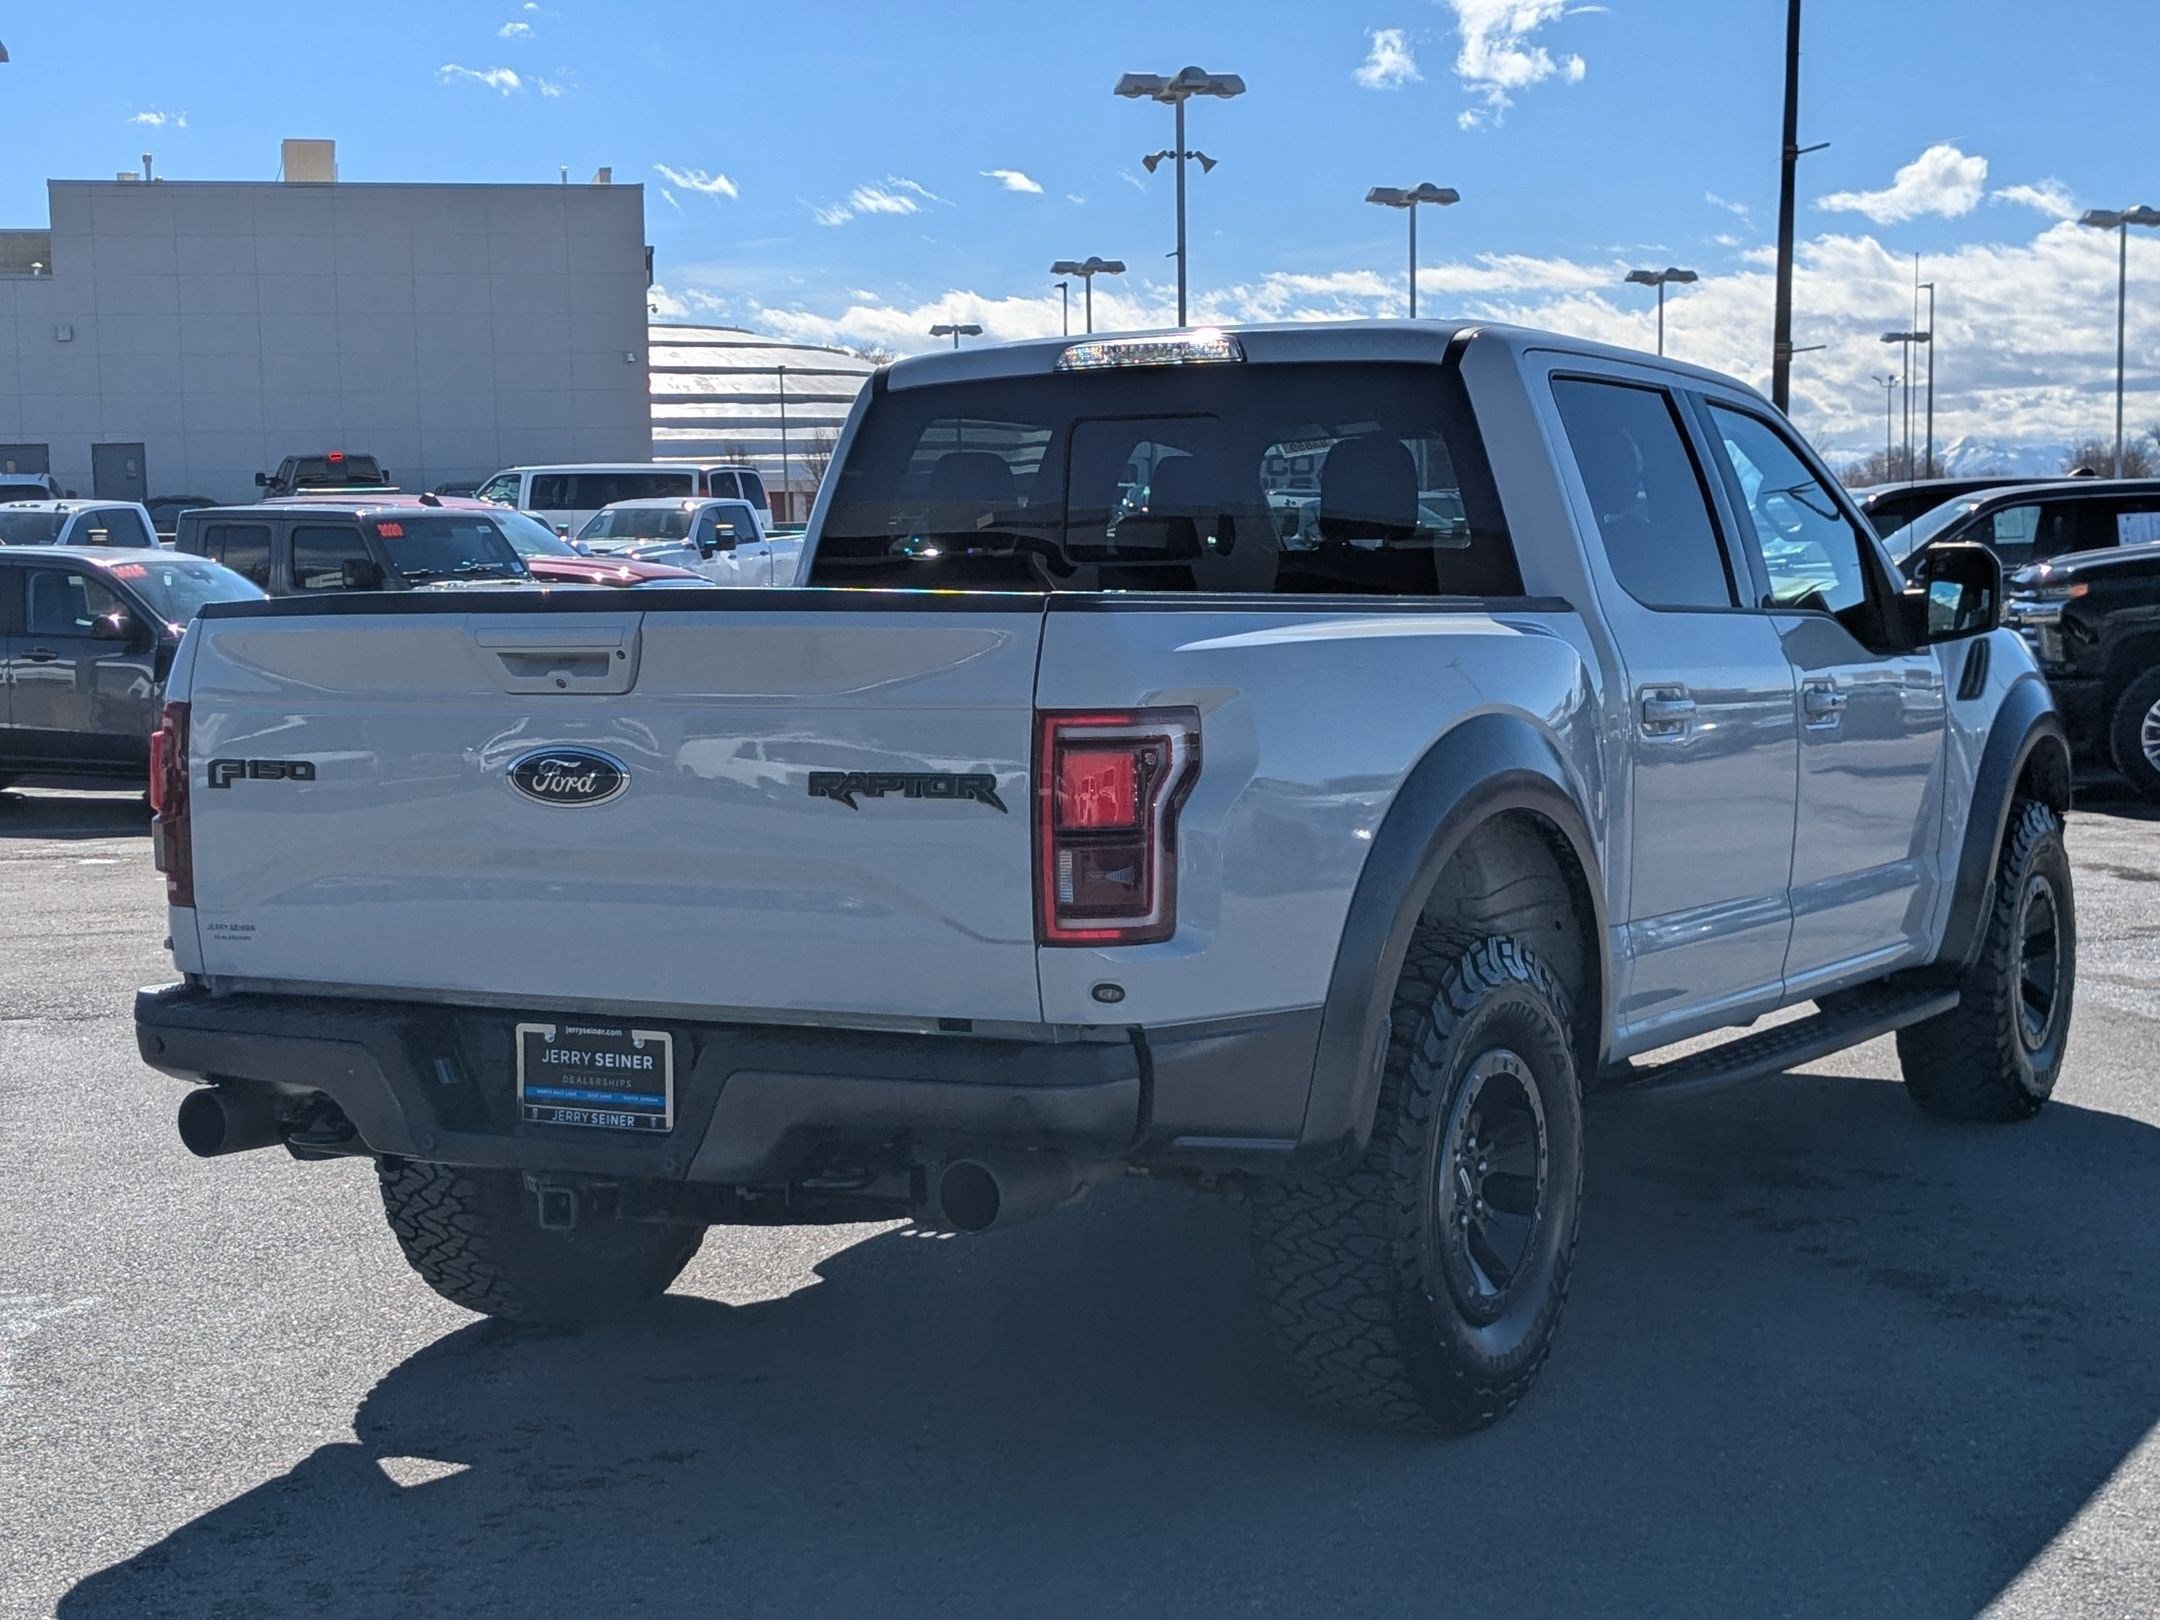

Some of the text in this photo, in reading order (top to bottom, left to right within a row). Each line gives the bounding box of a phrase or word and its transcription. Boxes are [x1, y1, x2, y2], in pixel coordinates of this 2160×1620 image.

[532, 759, 596, 792] Ford
[808, 772, 1008, 814] RAPTOR
[566, 1025, 622, 1037] jerryseiner.com
[542, 1050, 653, 1069] JERRY SEINER
[562, 1075, 632, 1088] DEALERSHIPS
[552, 1109, 635, 1127] JERRY SEINER
